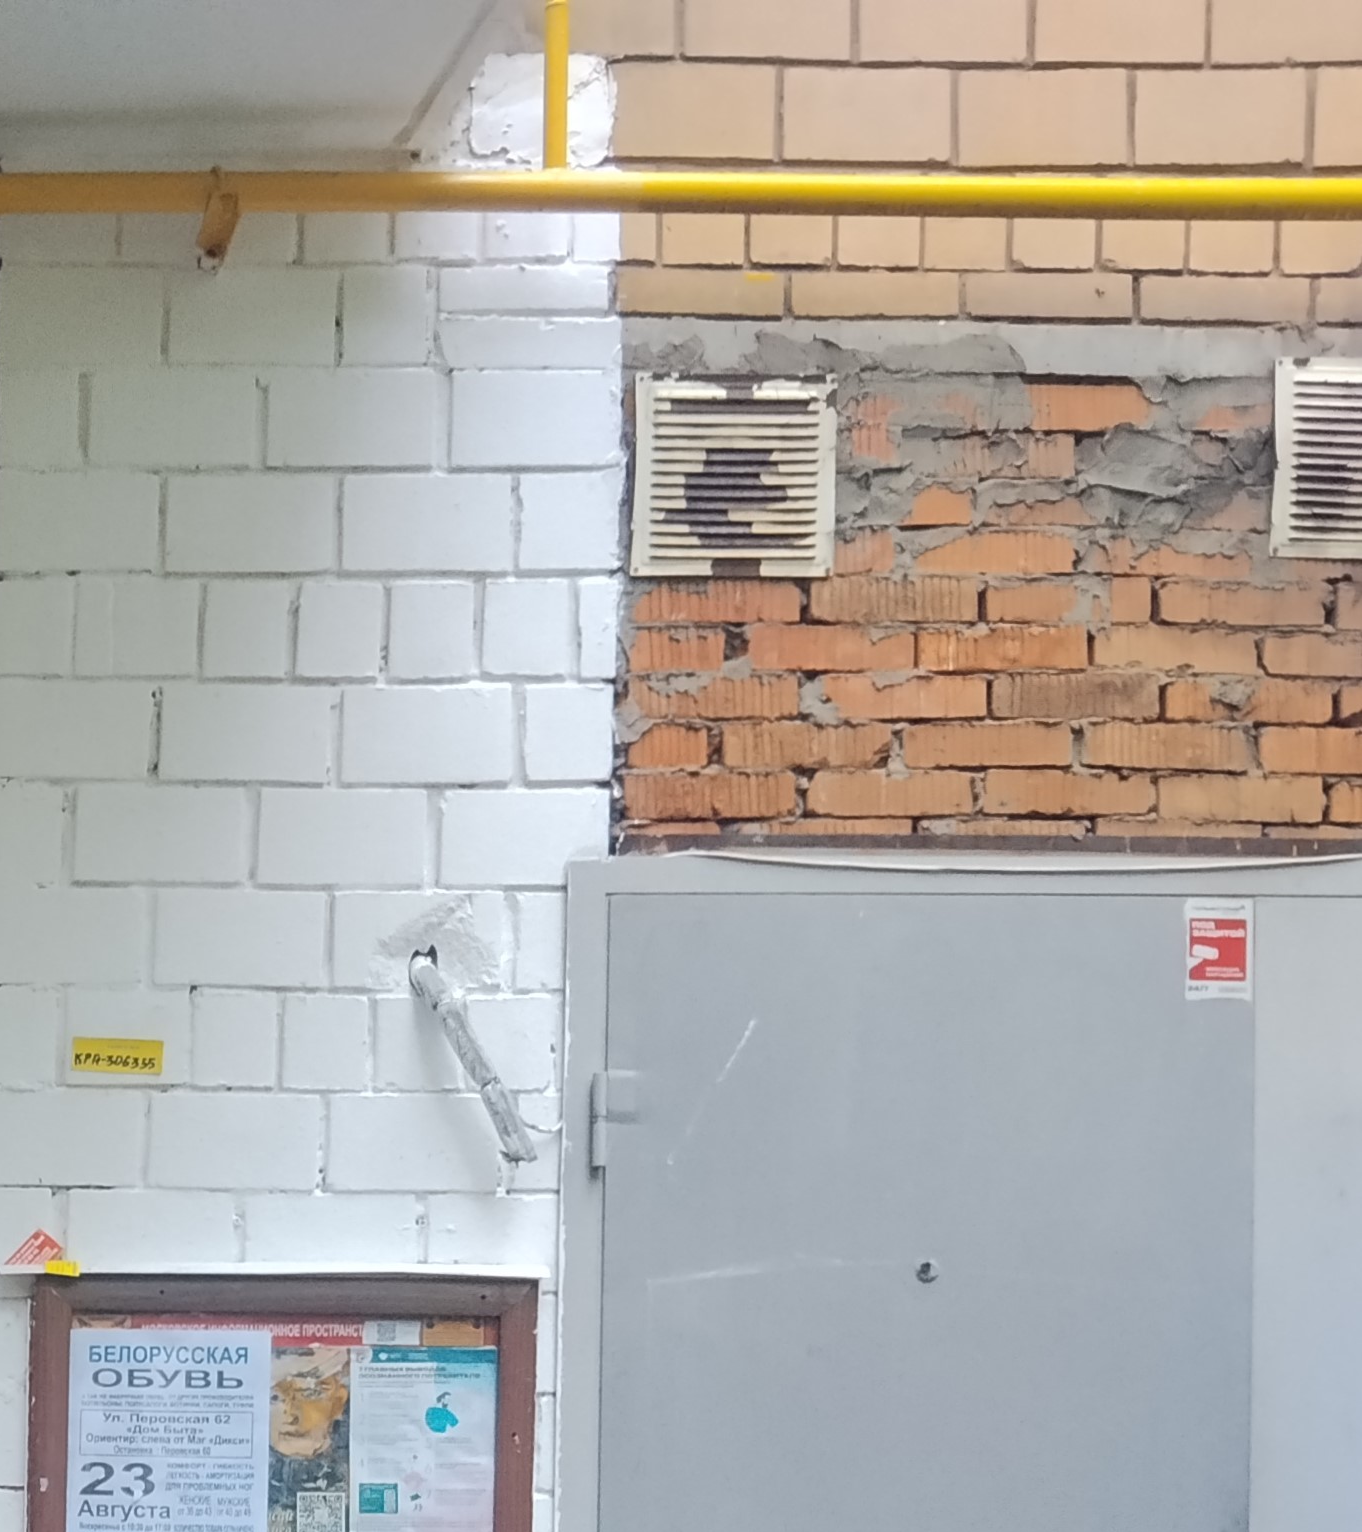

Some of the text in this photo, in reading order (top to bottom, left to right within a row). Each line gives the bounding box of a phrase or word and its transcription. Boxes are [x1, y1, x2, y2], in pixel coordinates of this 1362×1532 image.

[88, 1345, 248, 1364] БЕЛОРУССКАЯ
[92, 1368, 244, 1390] ОБУВЬ
[103, 1412, 231, 1425] Ул. Перовская 62
[86, 1433, 138, 1444] Ориентир:
[79, 1462, 156, 1497] 23
[78, 1500, 171, 1522] Августа
